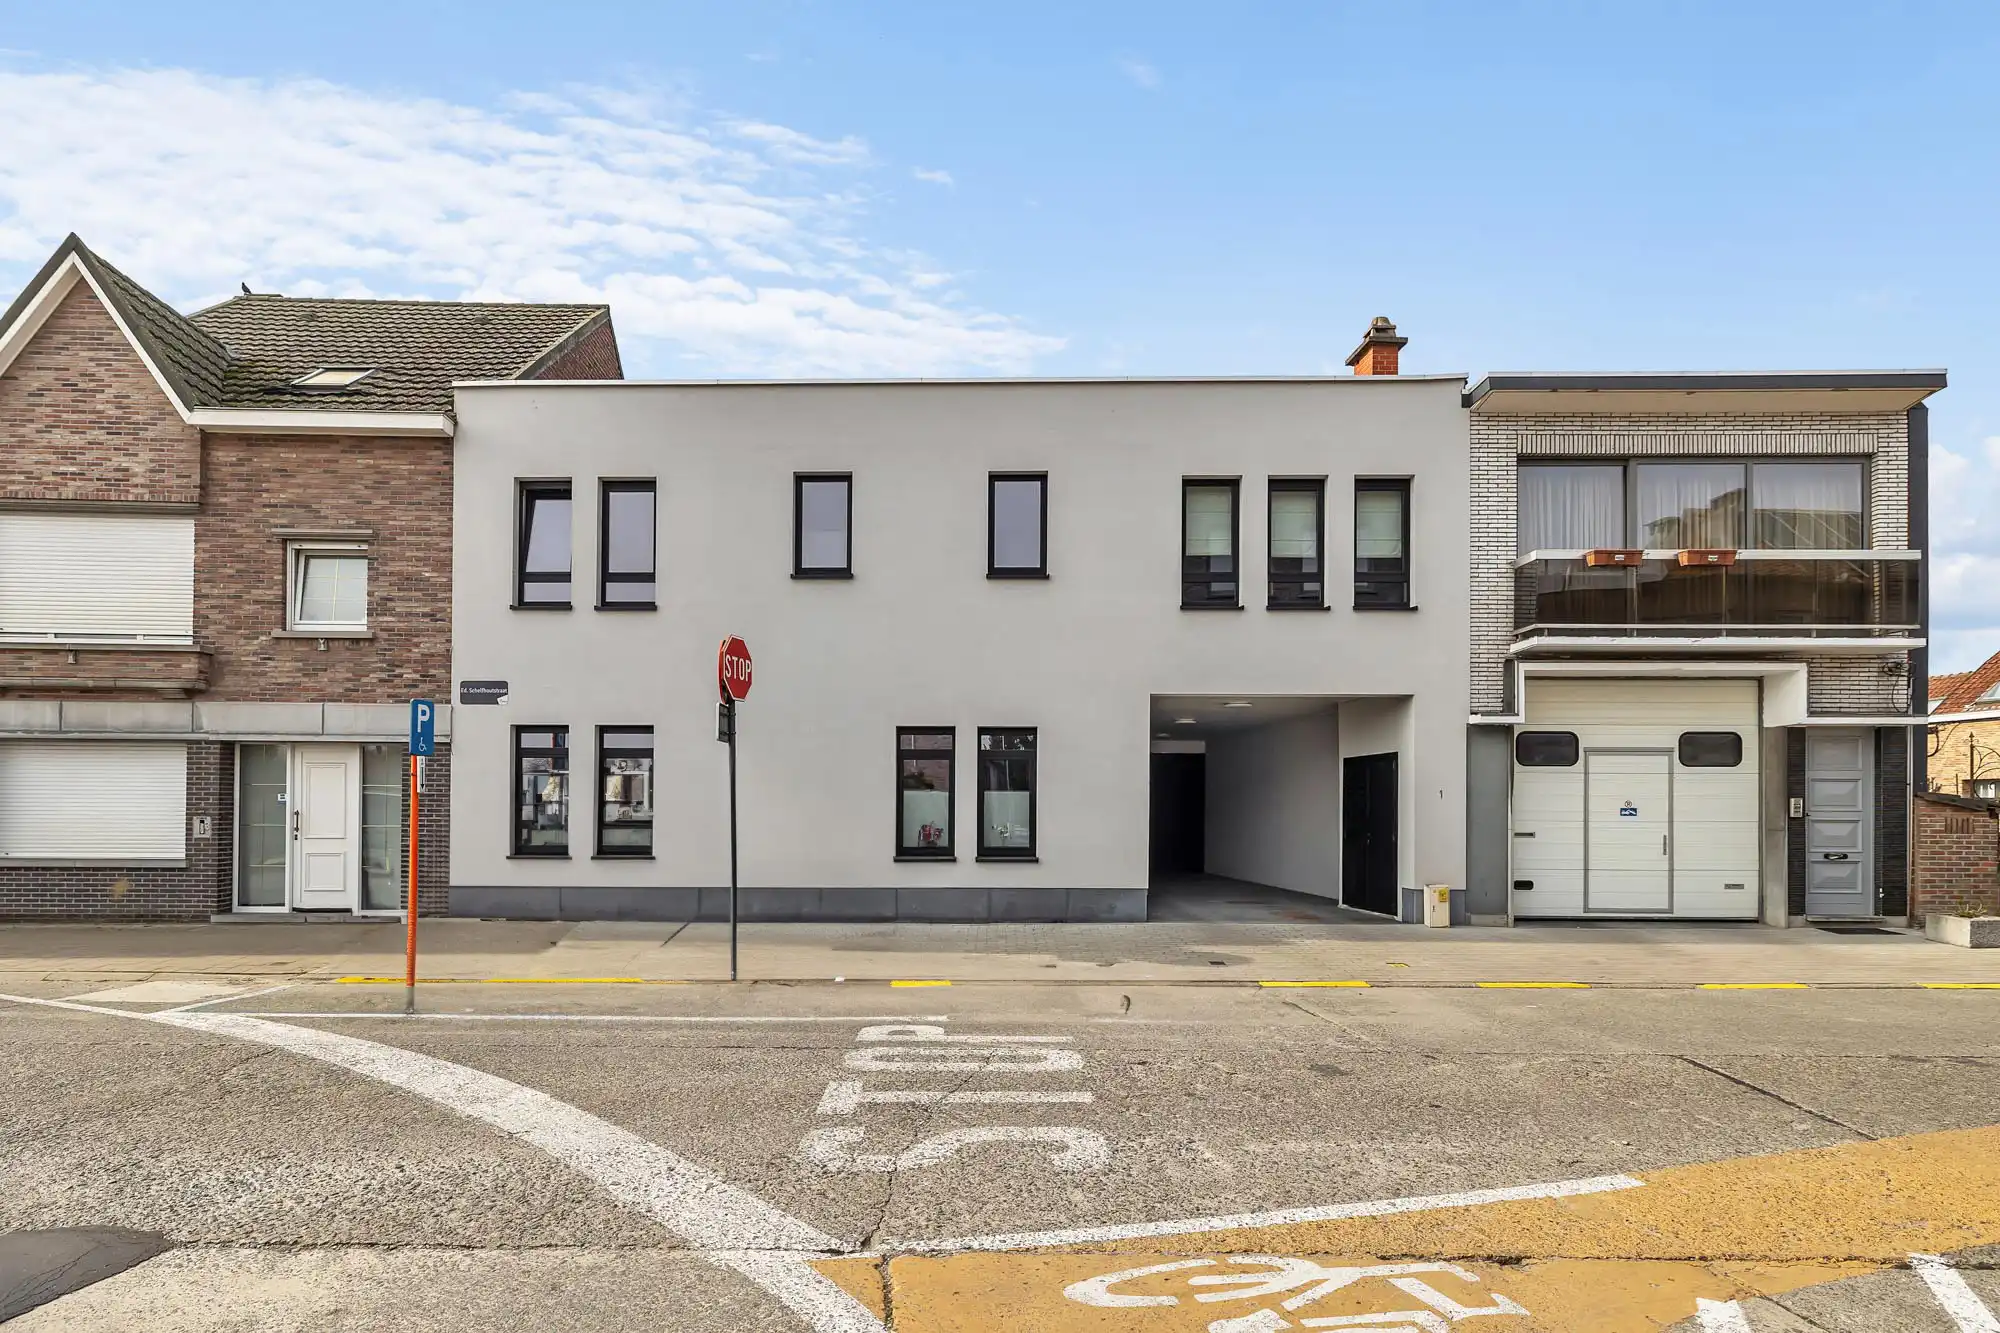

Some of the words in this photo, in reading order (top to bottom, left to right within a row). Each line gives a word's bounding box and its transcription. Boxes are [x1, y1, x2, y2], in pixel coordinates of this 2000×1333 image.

[725, 654, 752, 682] STOP
[417, 703, 430, 733] P
[799, 1024, 1111, 1172] STOP
